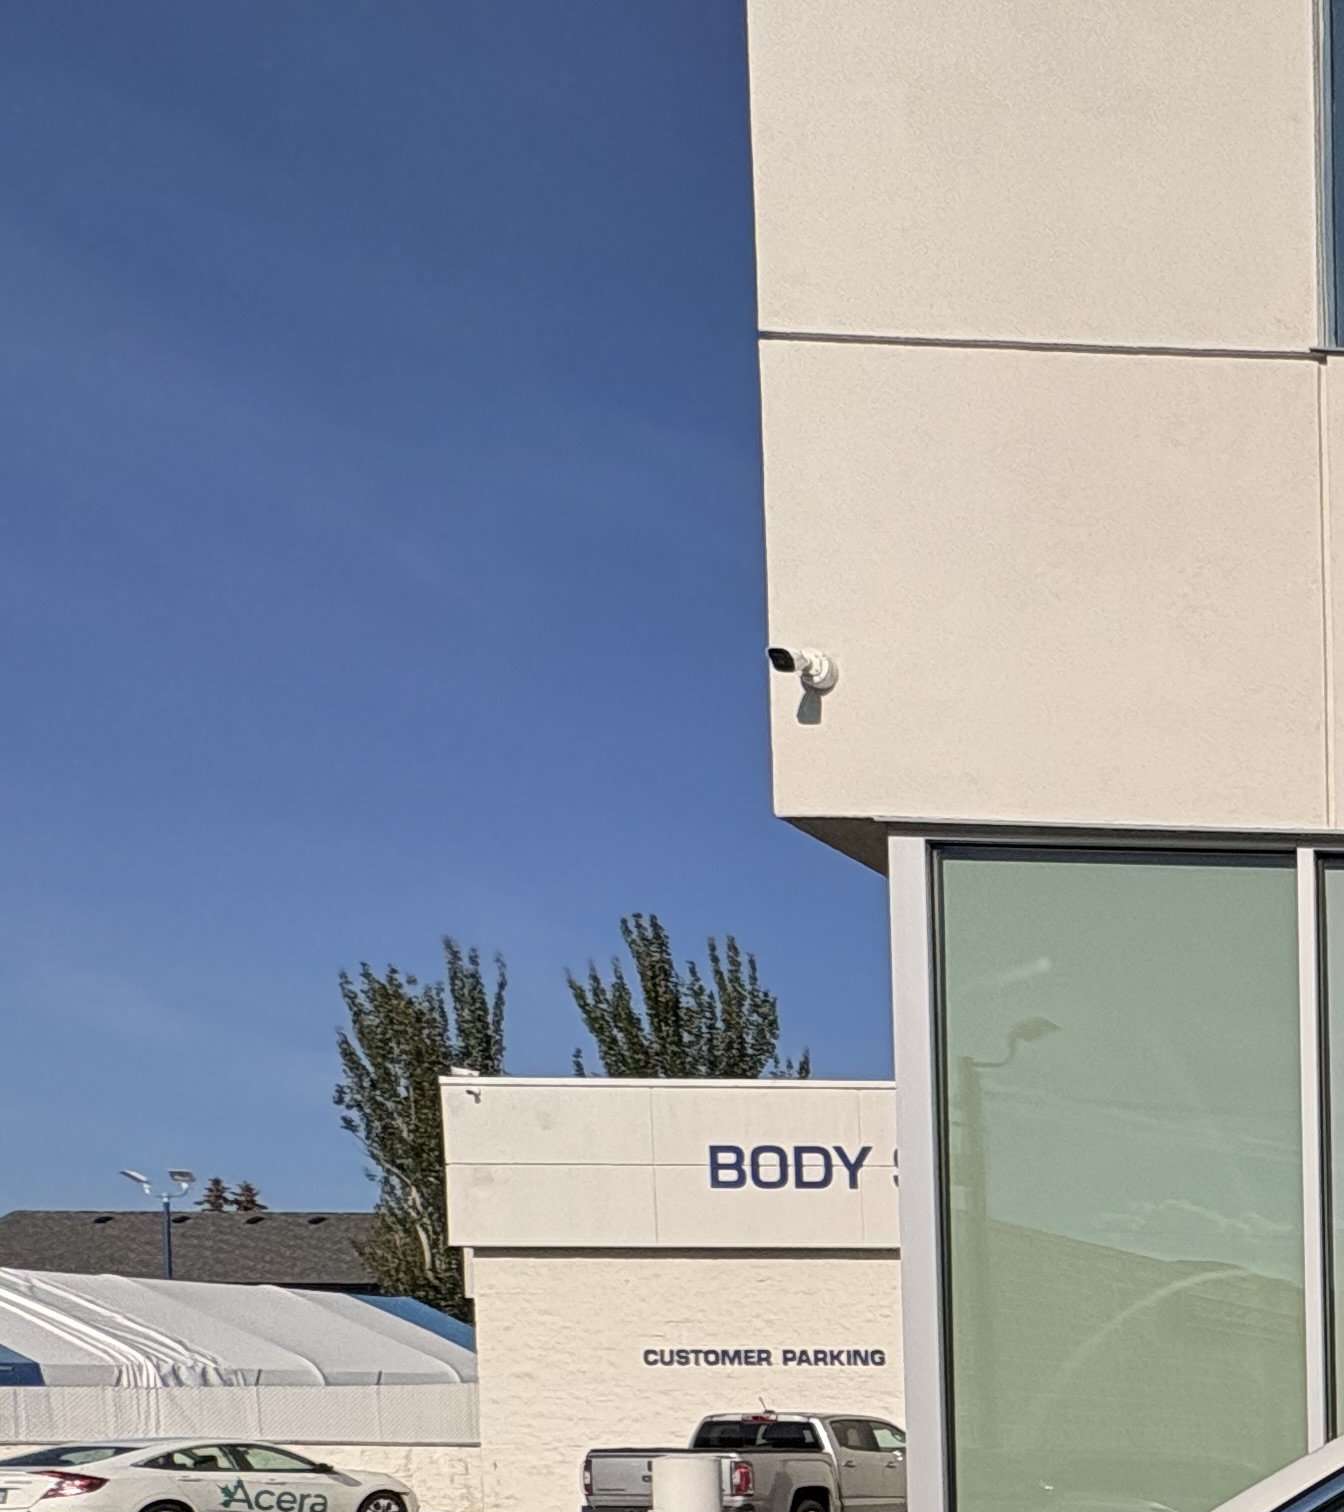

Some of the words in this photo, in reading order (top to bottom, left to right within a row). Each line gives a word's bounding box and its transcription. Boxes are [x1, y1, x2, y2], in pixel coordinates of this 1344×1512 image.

[709, 1145, 873, 1189] BODY
[643, 1350, 773, 1366] CUSTOMER
[782, 1350, 887, 1366] PARKING
